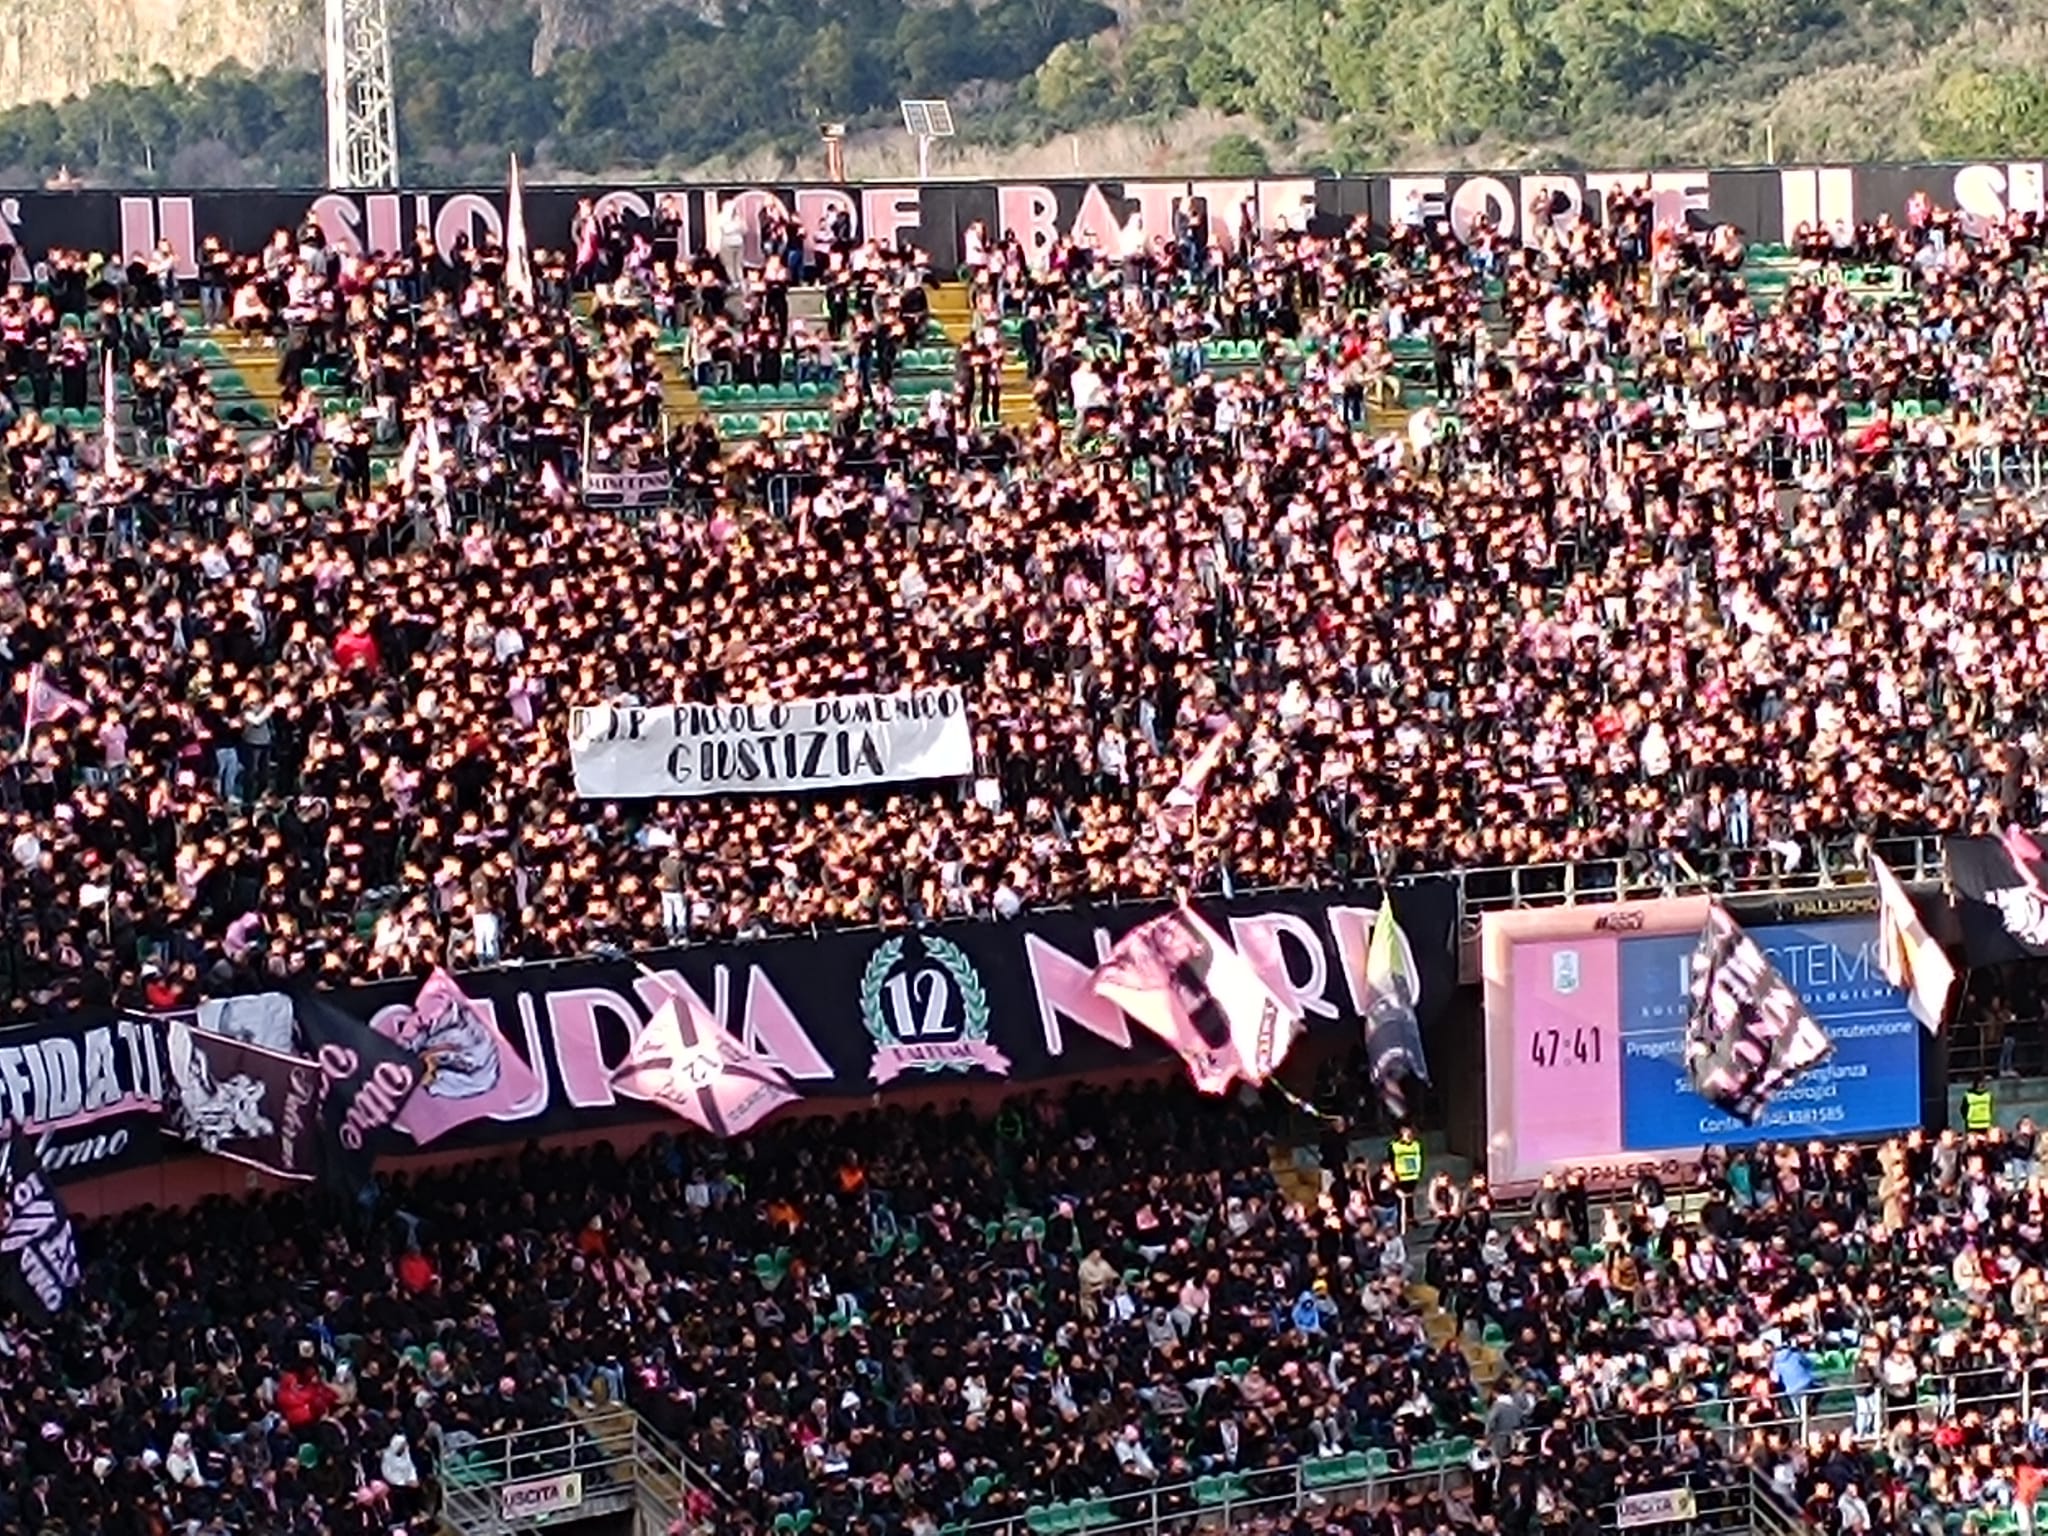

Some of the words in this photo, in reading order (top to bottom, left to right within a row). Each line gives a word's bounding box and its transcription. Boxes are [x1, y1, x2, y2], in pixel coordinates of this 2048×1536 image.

[667, 728, 885, 783] GIUSTIZIA
[884, 968, 957, 1036] 12
[1531, 1025, 1601, 1067] 47:41
